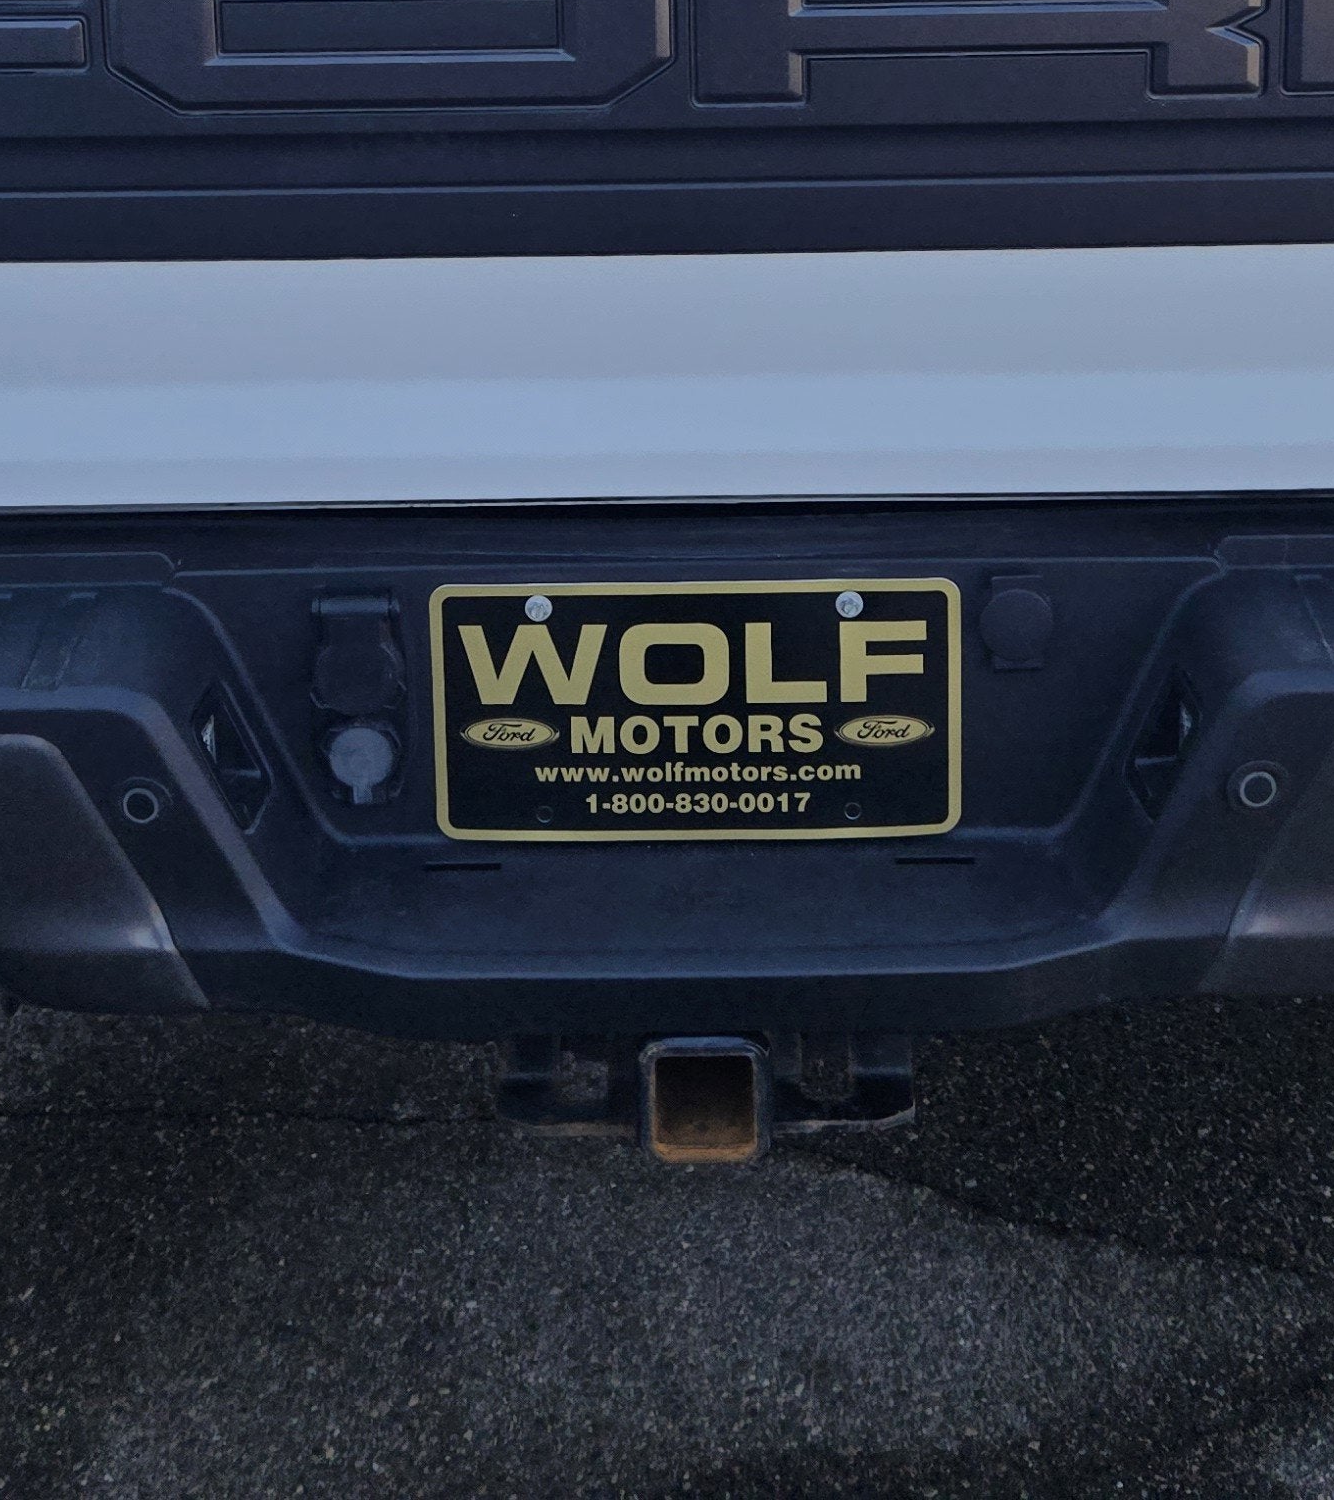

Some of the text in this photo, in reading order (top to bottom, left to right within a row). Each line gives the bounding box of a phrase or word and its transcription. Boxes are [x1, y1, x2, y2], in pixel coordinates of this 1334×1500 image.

[457, 619, 928, 706] WOLF
[481, 722, 537, 743] Ford
[569, 713, 825, 754] MOTORS
[855, 720, 912, 741] Ford
[534, 761, 862, 783] www.wolfmotors.com
[584, 792, 812, 815] 1-800-830-0017
